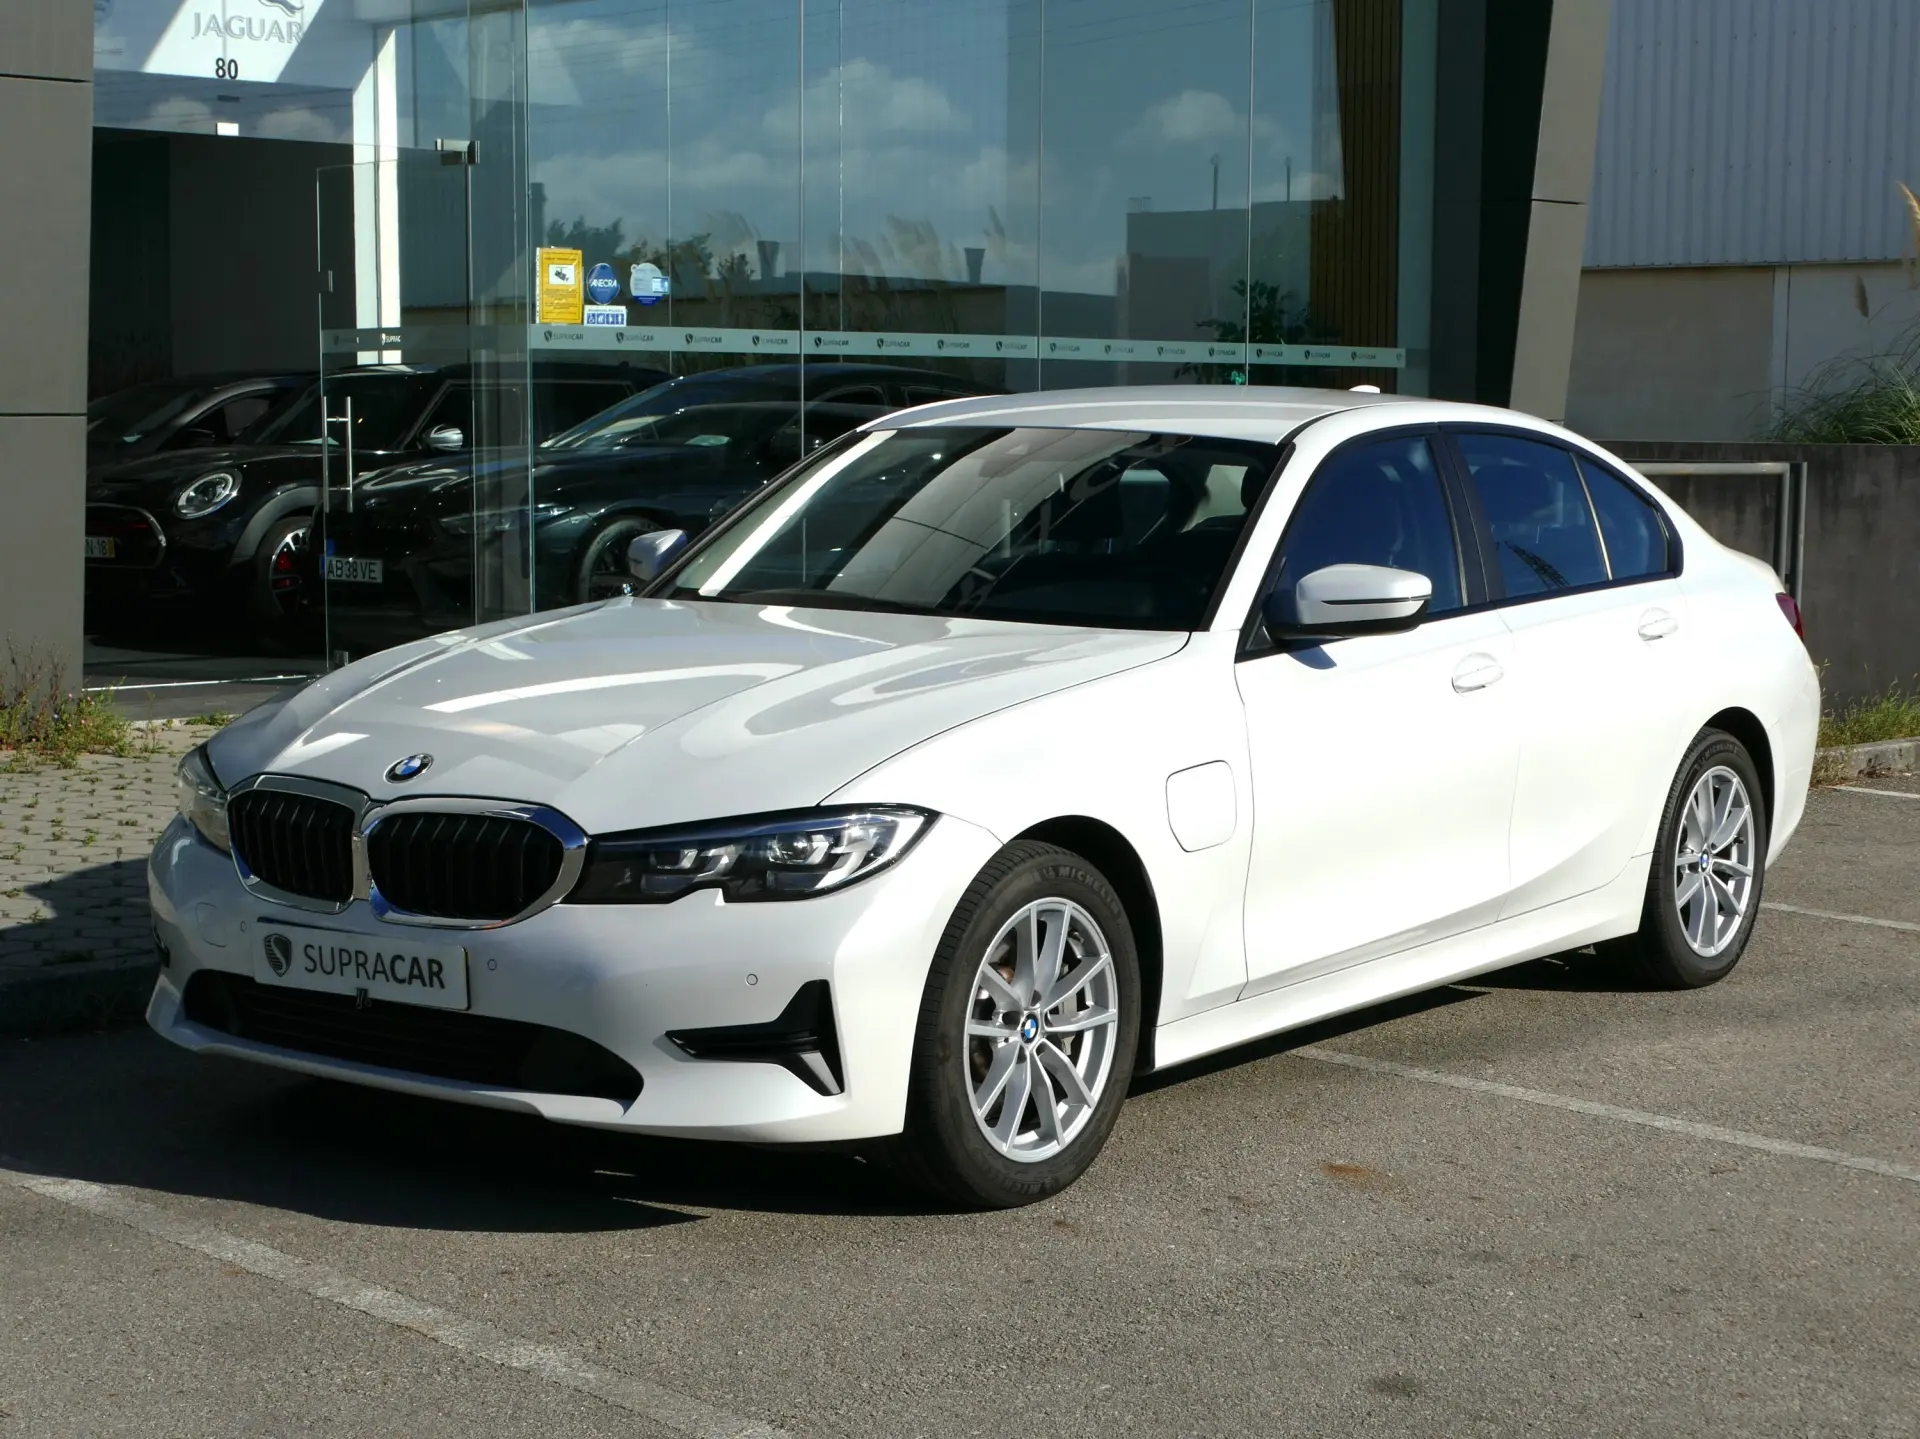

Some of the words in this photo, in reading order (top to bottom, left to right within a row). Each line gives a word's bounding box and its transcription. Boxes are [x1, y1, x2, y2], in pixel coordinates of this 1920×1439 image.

[191, 12, 303, 44] JAGUAR
[215, 57, 239, 80] 80
[590, 279, 618, 288] ANECRA
[552, 332, 584, 341] SUPRACAR
[1058, 866, 1120, 915] MICHELIN
[303, 943, 446, 990] SUPRACAR
